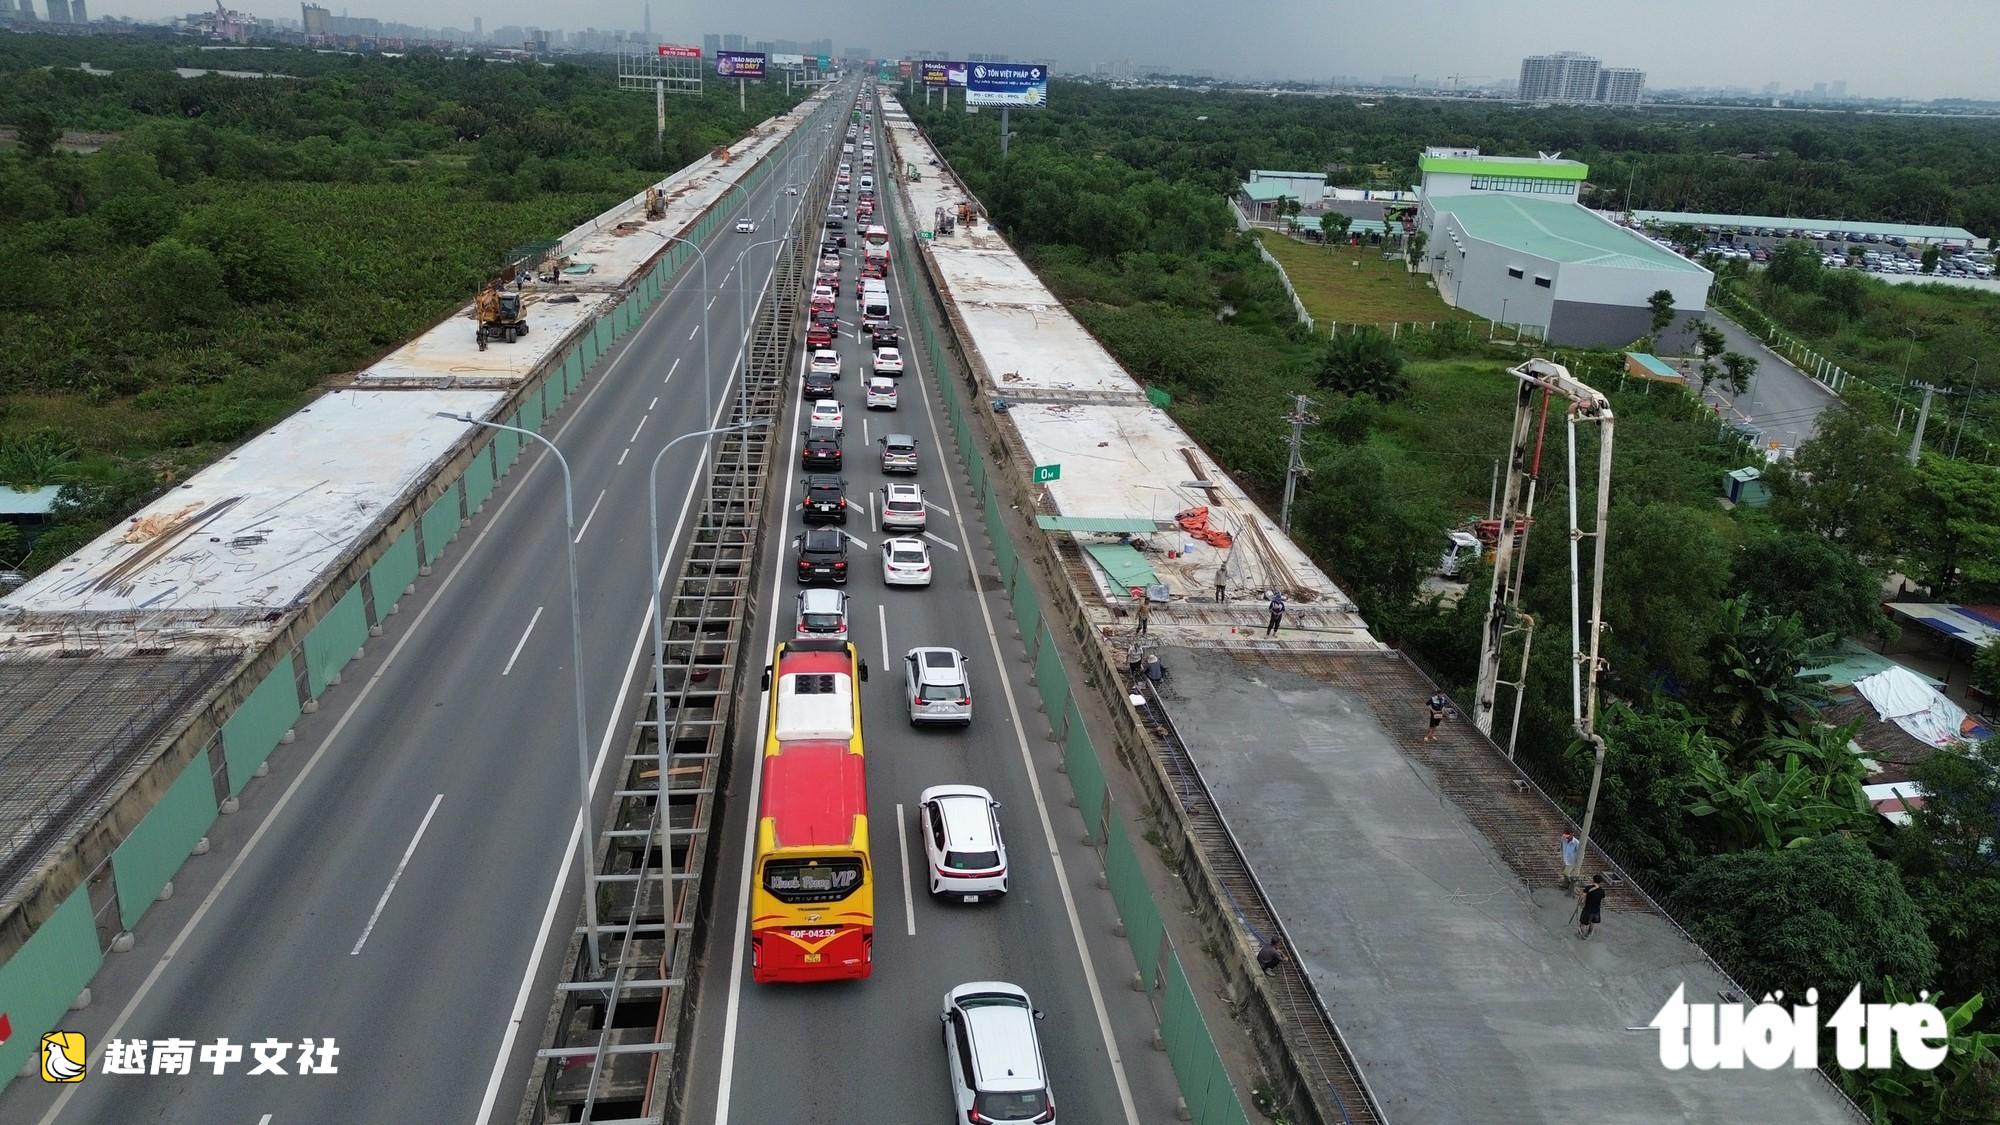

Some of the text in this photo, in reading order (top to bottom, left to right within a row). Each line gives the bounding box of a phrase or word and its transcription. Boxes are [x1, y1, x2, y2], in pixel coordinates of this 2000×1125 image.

[988, 69, 1029, 79] TÔN VIỆT PHÁP
[831, 870, 856, 887] VIP
[787, 894, 842, 902] UNIVERSE
